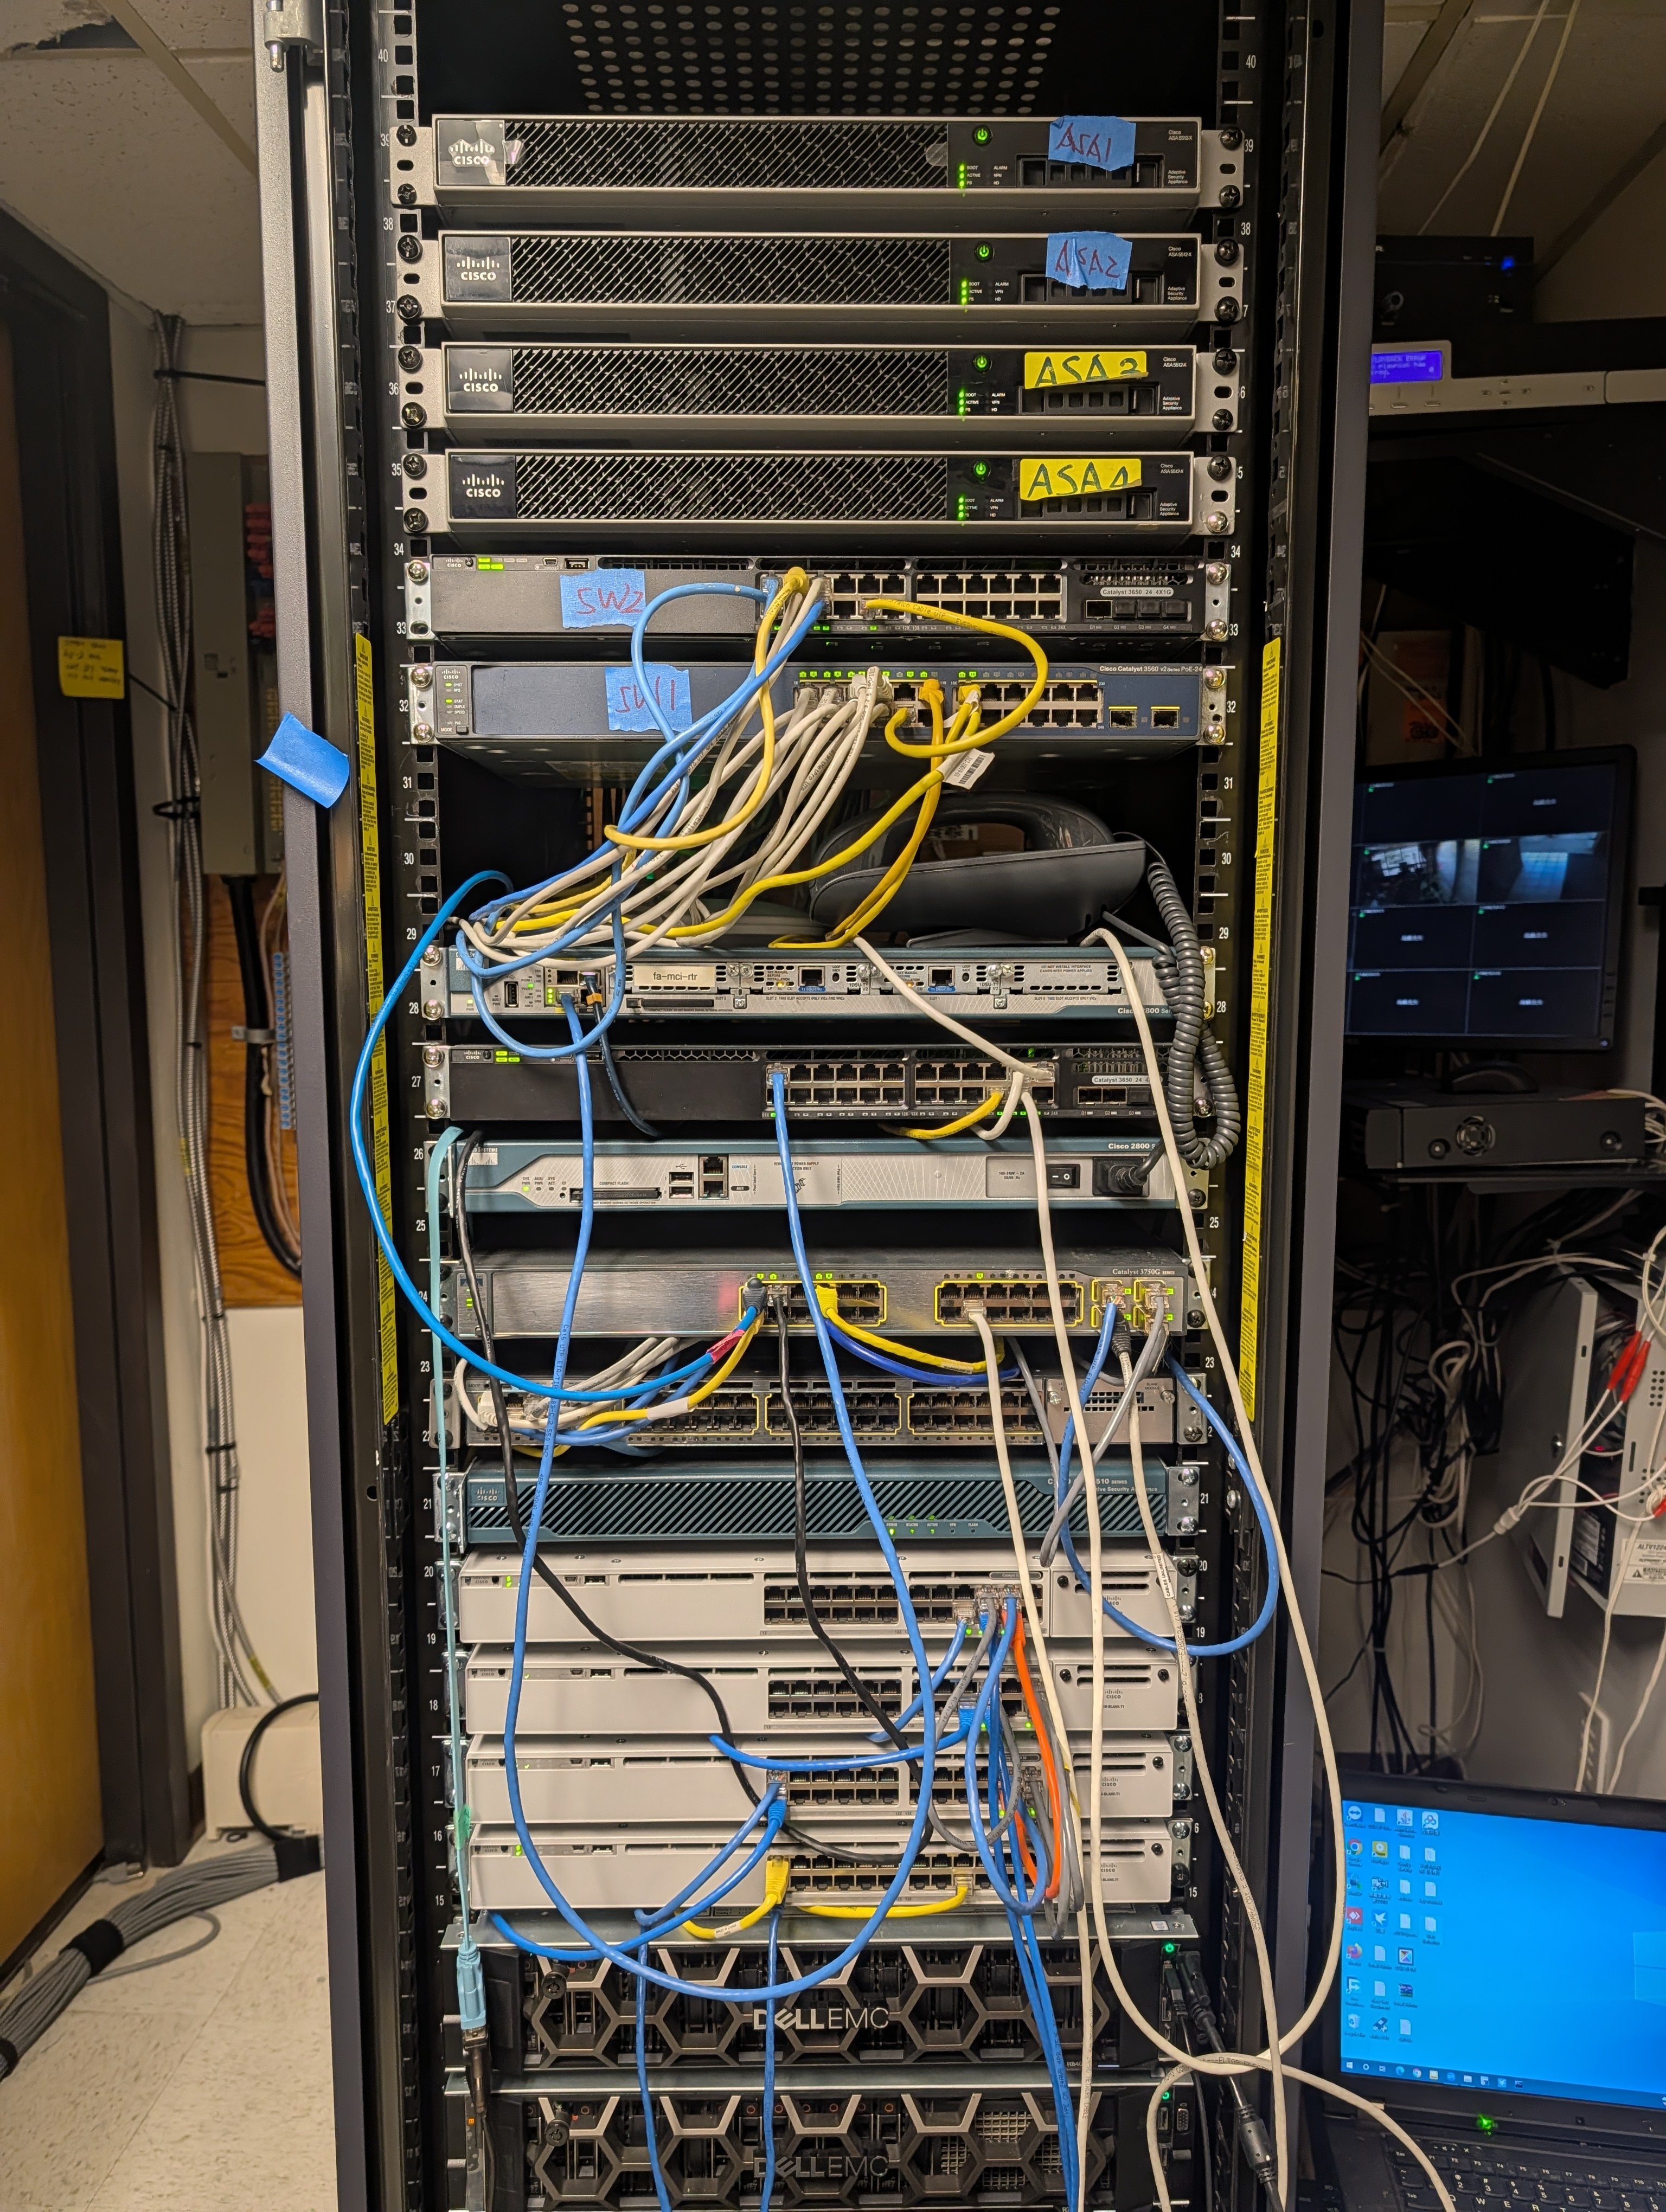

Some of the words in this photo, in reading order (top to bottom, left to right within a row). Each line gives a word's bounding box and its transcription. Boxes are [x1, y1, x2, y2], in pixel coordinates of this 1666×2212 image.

[378, 49, 388, 62] 40
[1246, 55, 1256, 68] 40
[454, 156, 489, 165] CISCO
[383, 217, 393, 230] 38
[1241, 222, 1251, 235] 38
[461, 272, 496, 281] CISCO
[389, 382, 399, 395] 36
[463, 383, 498, 392] CISCO
[392, 464, 401, 476] 35
[466, 488, 501, 498] CISCO
[394, 543, 404, 556] 34
[1231, 545, 1241, 558] 34
[913, 603, 931, 614] Cable
[396, 622, 406, 634] 33
[1229, 624, 1238, 636] 33
[399, 700, 409, 712] 32
[1227, 701, 1236, 713] 32
[402, 776, 412, 789] 31
[1224, 777, 1233, 789] 31
[404, 853, 414, 865] 30
[1221, 853, 1231, 865] 30
[406, 928, 416, 940] 29
[1219, 928, 1228, 939] 29
[653, 972, 697, 981] fa-mci-rtr
[409, 1002, 419, 1014] 28
[1216, 1001, 1226, 1013] 28
[412, 1076, 421, 1088] 27
[414, 1148, 424, 1160] 26
[416, 1220, 426, 1231] 25
[1210, 1217, 1219, 1229] 25
[420, 1361, 430, 1372] 23
[1206, 1358, 1214, 1368] 23
[423, 1499, 432, 1509] 21
[1200, 1494, 1209, 1504] 21
[1157, 1555, 1166, 1578] UNLIMITED
[1199, 1560, 1207, 1571] 20
[424, 1567, 434, 1578] 20
[1162, 1579, 1170, 1597] CABLES
[427, 1633, 436, 1644] 19
[1196, 1628, 1205, 1638] 19
[429, 1700, 438, 1711] 18
[431, 1766, 440, 1777] 17
[433, 1831, 443, 1842] 16
[1188, 1888, 1197, 1898] 15
[435, 1895, 444, 1906] 15
[1476, 2197, 1485, 2205] W
[1503, 2200, 1511, 2208] E
